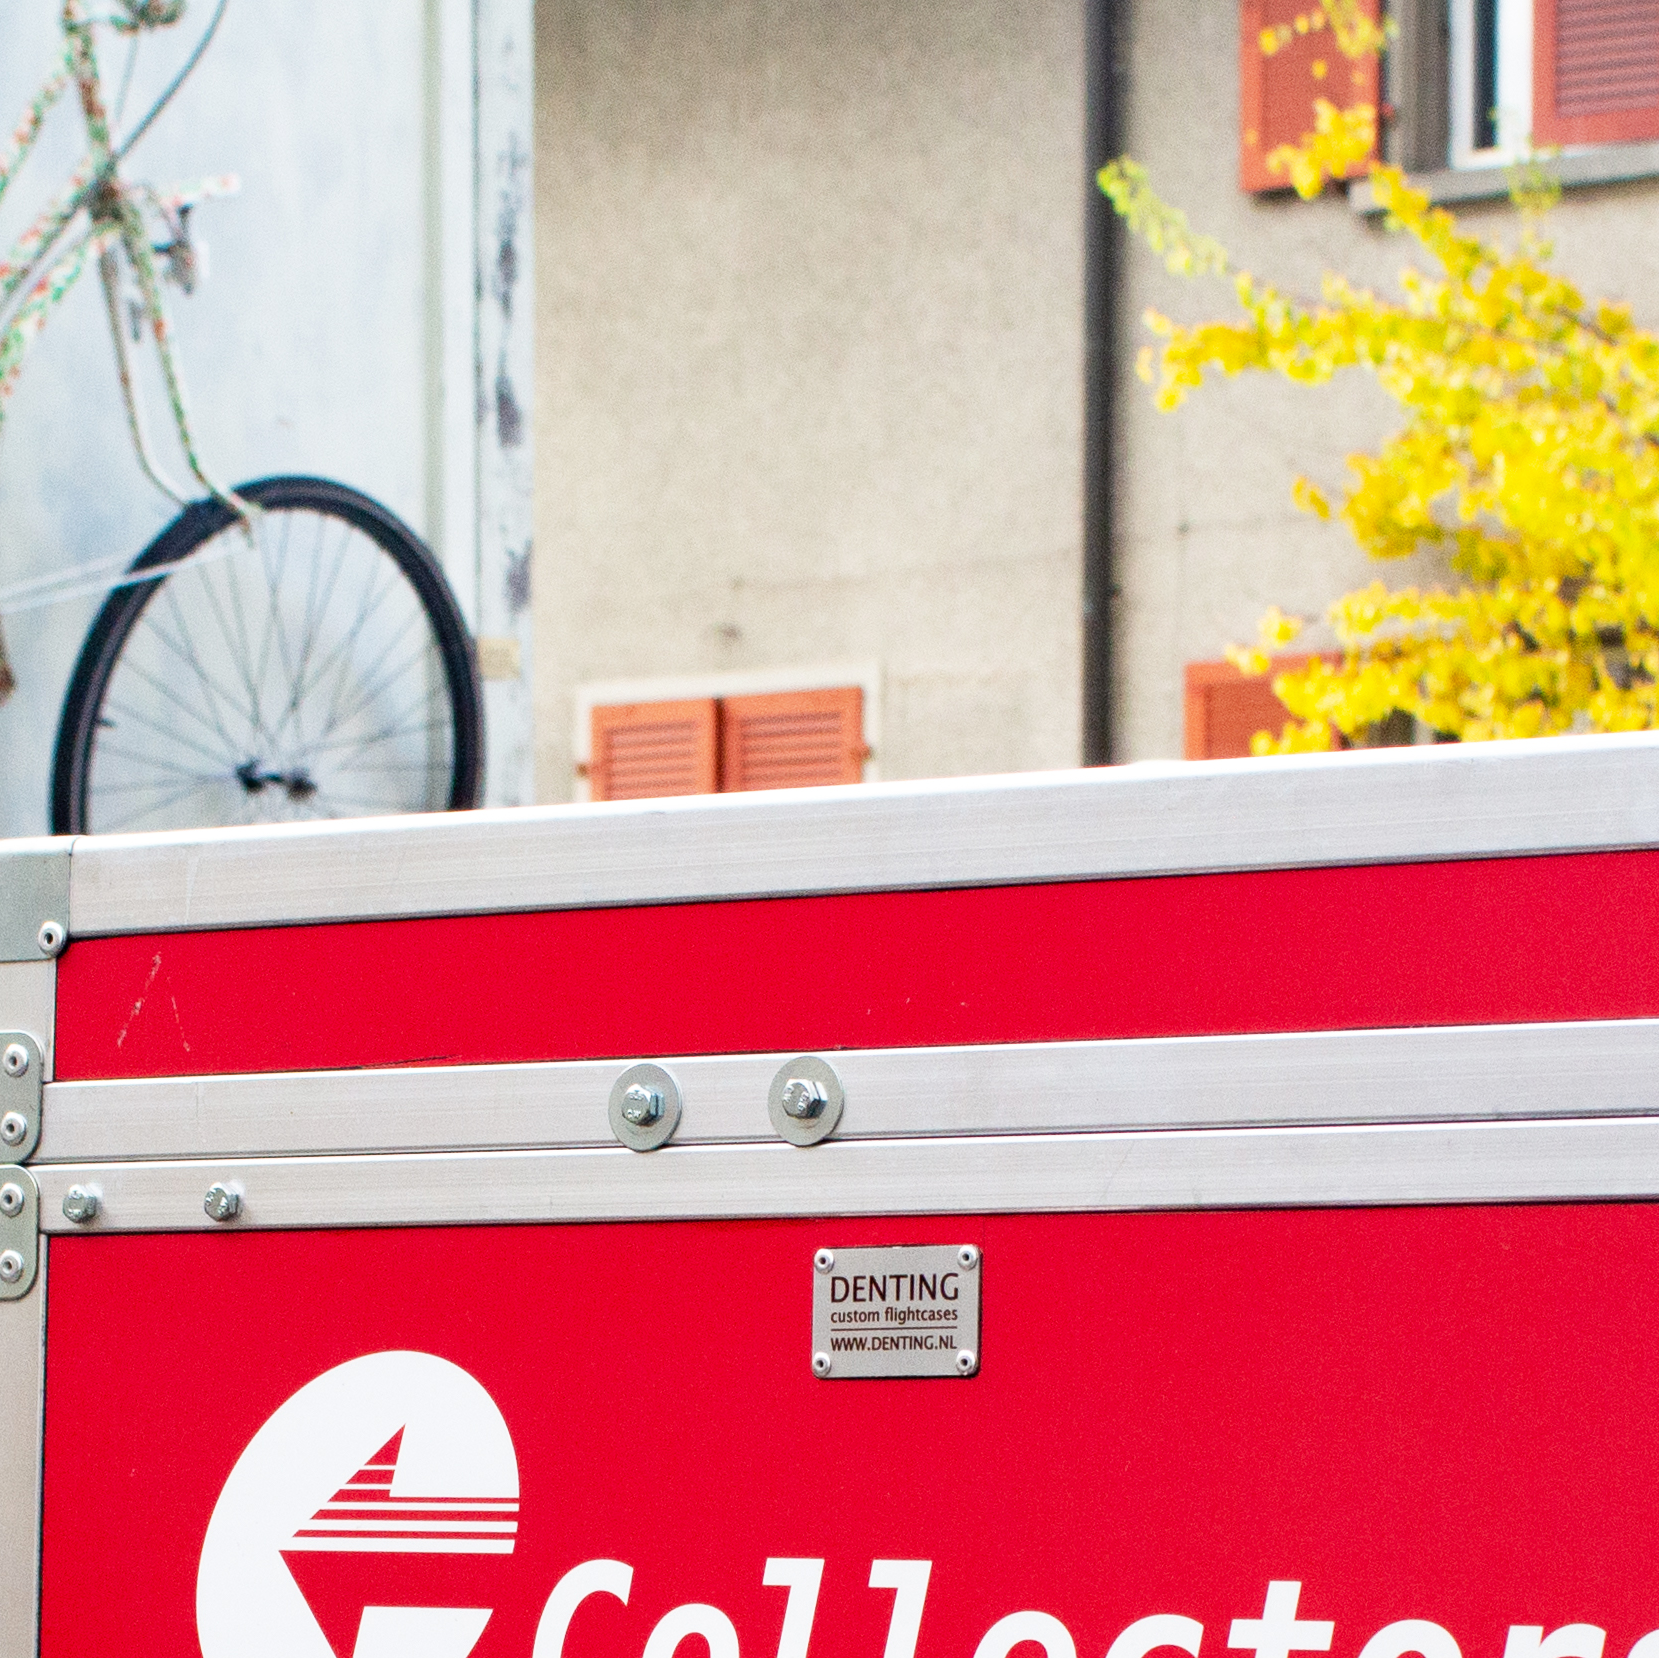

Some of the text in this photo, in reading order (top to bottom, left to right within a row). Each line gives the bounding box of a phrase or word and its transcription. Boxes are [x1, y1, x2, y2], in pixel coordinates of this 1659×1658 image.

[830, 1272, 959, 1303] DENTING
[830, 1306, 958, 1325] custom flightcases
[830, 1335, 958, 1351] WWW.DENTING.NL
